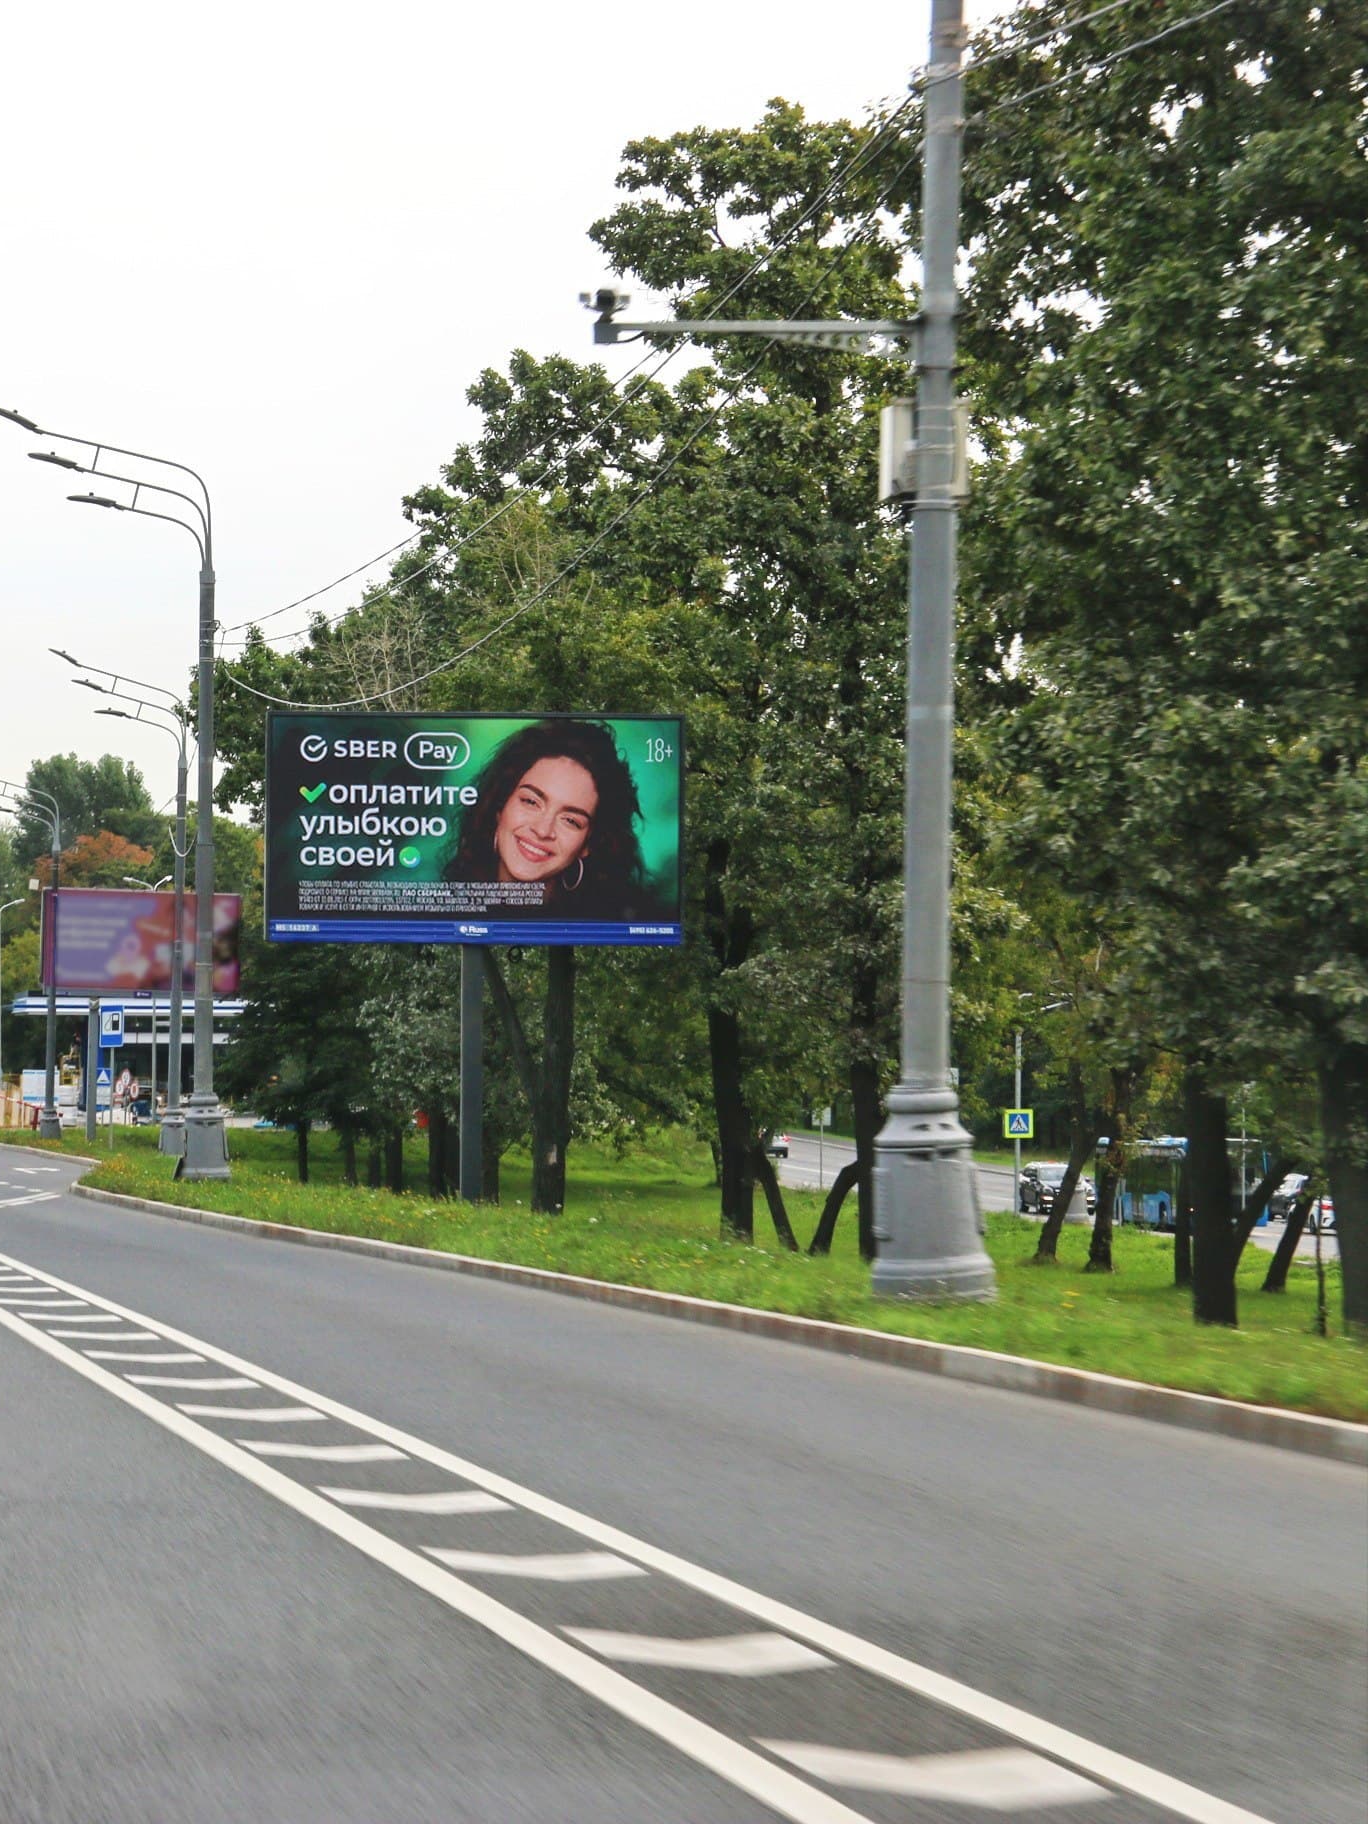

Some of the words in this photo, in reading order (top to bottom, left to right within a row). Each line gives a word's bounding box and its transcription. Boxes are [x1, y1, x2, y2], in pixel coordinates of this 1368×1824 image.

[334, 740, 397, 758] SBER
[419, 741, 457, 763] Pay
[645, 738, 673, 762] 18+
[329, 784, 478, 805] оплатите
[299, 807, 447, 841] улыбкою
[299, 839, 395, 866] своей
